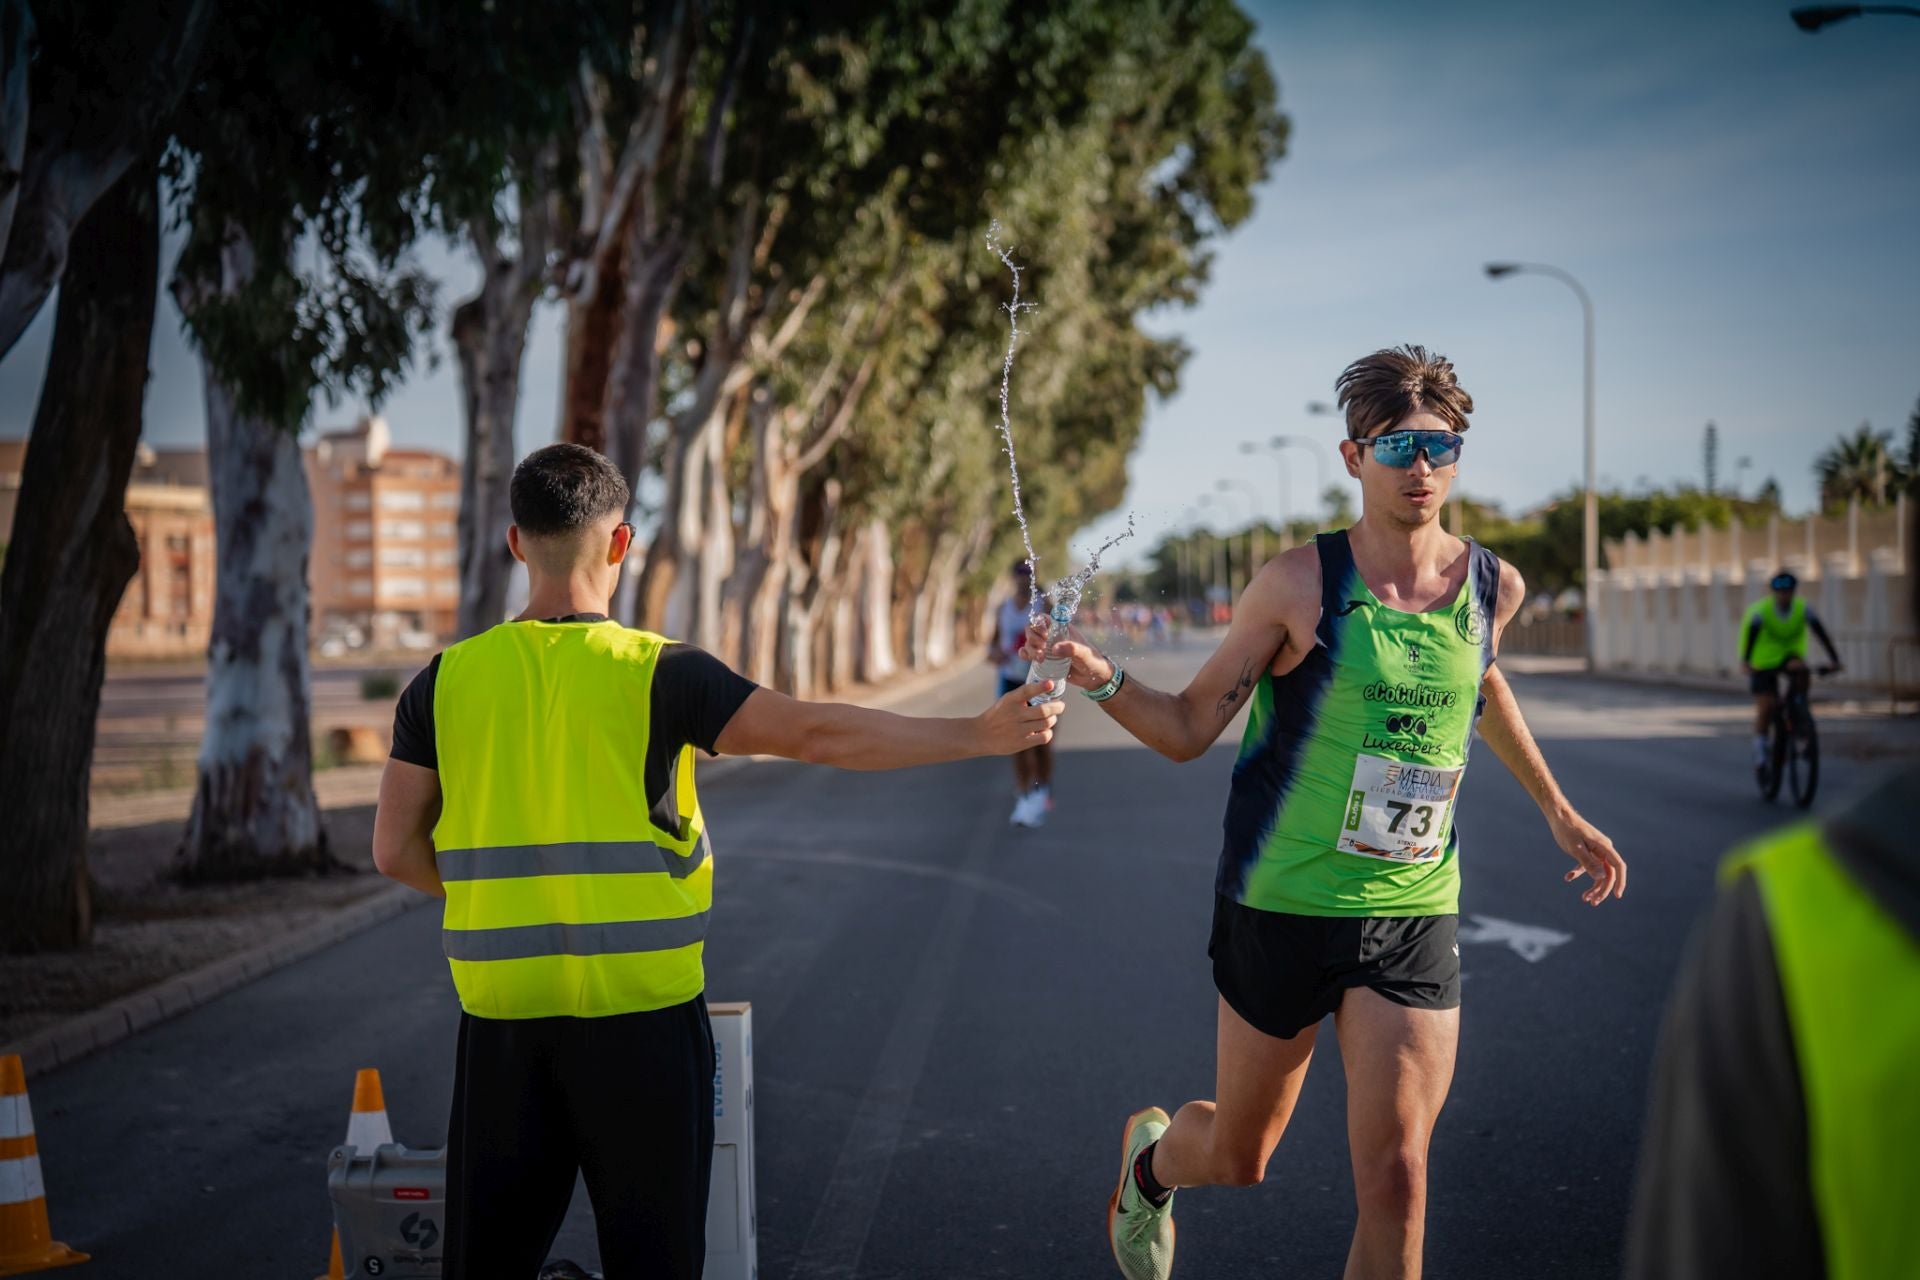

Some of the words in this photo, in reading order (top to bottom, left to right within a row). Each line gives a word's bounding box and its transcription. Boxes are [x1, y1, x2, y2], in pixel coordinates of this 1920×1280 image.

[1363, 680, 1456, 708] eCoCulture
[1362, 733, 1442, 759] Luxeapers
[1398, 767, 1441, 787] MEDIA
[1386, 800, 1433, 837] 73
